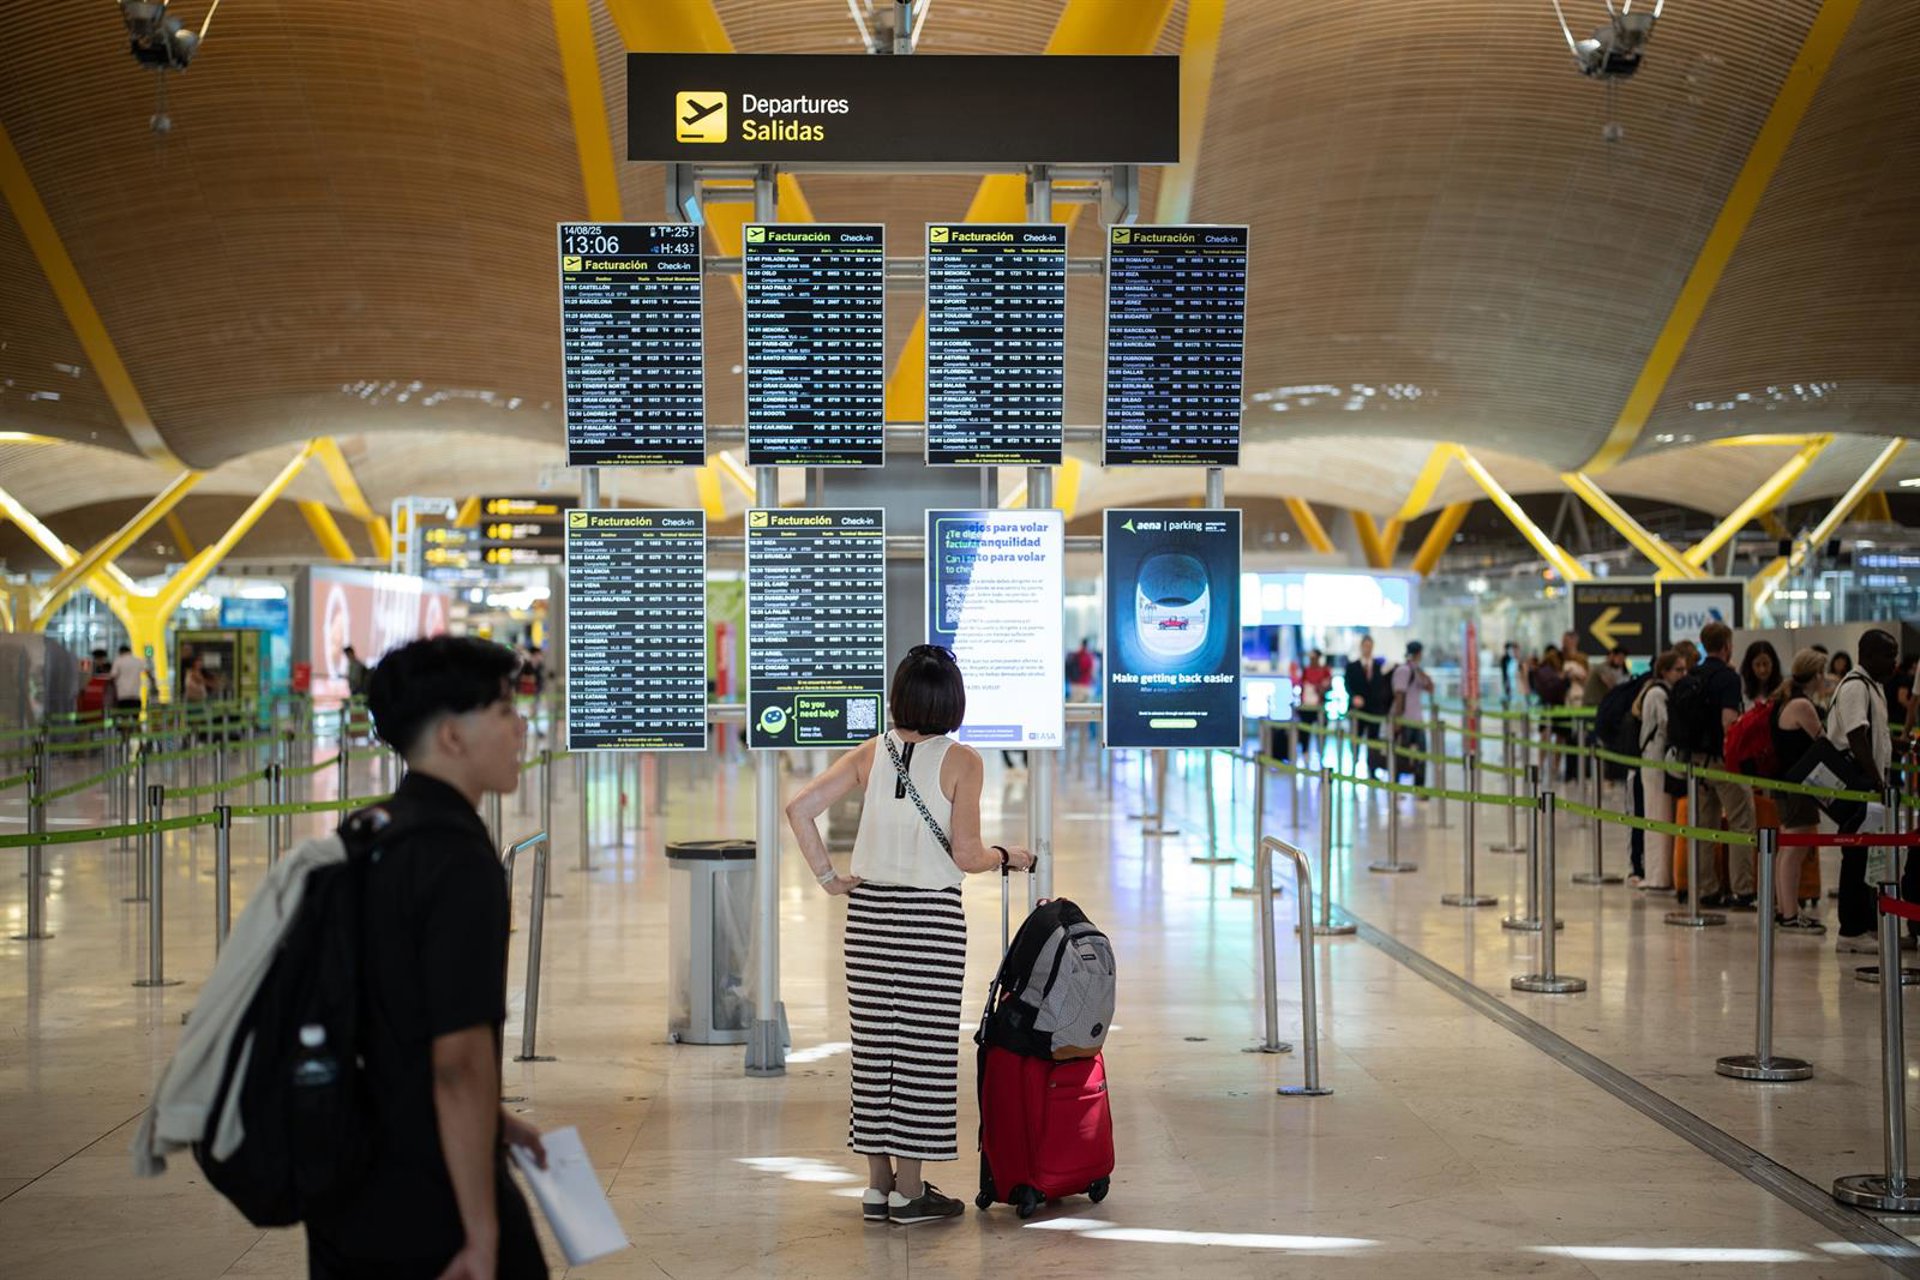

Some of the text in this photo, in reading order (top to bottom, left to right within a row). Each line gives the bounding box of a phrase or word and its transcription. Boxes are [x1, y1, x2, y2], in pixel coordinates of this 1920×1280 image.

[742, 94, 848, 118] Departures
[742, 120, 824, 142] Salidas
[564, 226, 601, 235] 14/08/25
[769, 232, 874, 242] Facturación Check-in
[952, 231, 1056, 242] Facturación Check-in
[1134, 233, 1238, 243] Facturación Check-in
[565, 236, 619, 254] 13:06
[585, 260, 690, 270] Facturación Check-in
[591, 517, 695, 527] Facturación Check-in
[771, 515, 874, 526] Facturación Check-in
[1137, 521, 1161, 530] aena
[1169, 520, 1202, 532] parking
[993, 524, 1018, 534] para
[1020, 522, 1048, 532] volar
[991, 554, 1015, 564] para
[1017, 552, 1045, 562] volar
[946, 566, 954, 574] to
[1112, 673, 1234, 685] Make getting back easier
[800, 700, 825, 710] Do you
[800, 709, 839, 719] need help?
